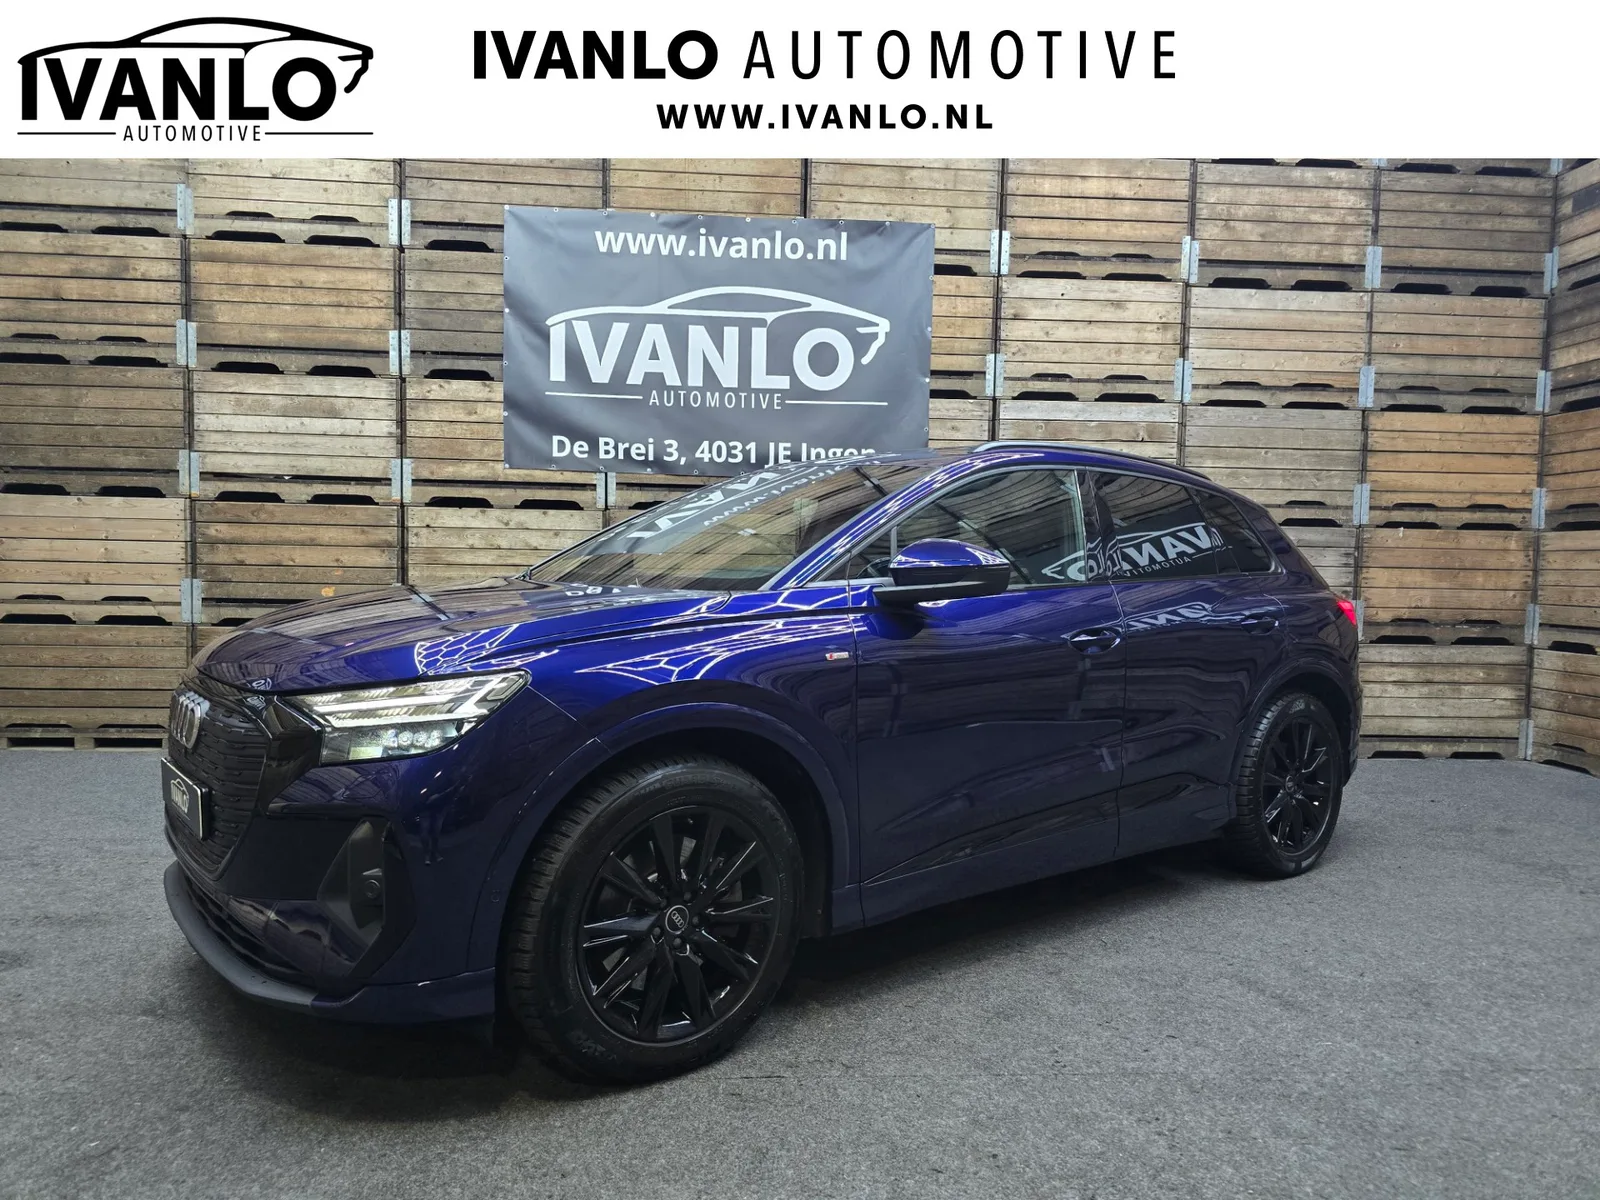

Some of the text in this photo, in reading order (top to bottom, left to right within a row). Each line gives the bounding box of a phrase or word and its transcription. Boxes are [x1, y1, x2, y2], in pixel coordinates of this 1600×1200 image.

[594, 228, 848, 261] www.ivanlo.nl
[549, 319, 855, 391] IVANLO
[648, 389, 782, 410] AUTOMOTIVE
[551, 435, 589, 459] De
[598, 436, 655, 461] Brei
[663, 439, 687, 466] 3,
[694, 440, 757, 464] 4031
[764, 441, 792, 469] JE
